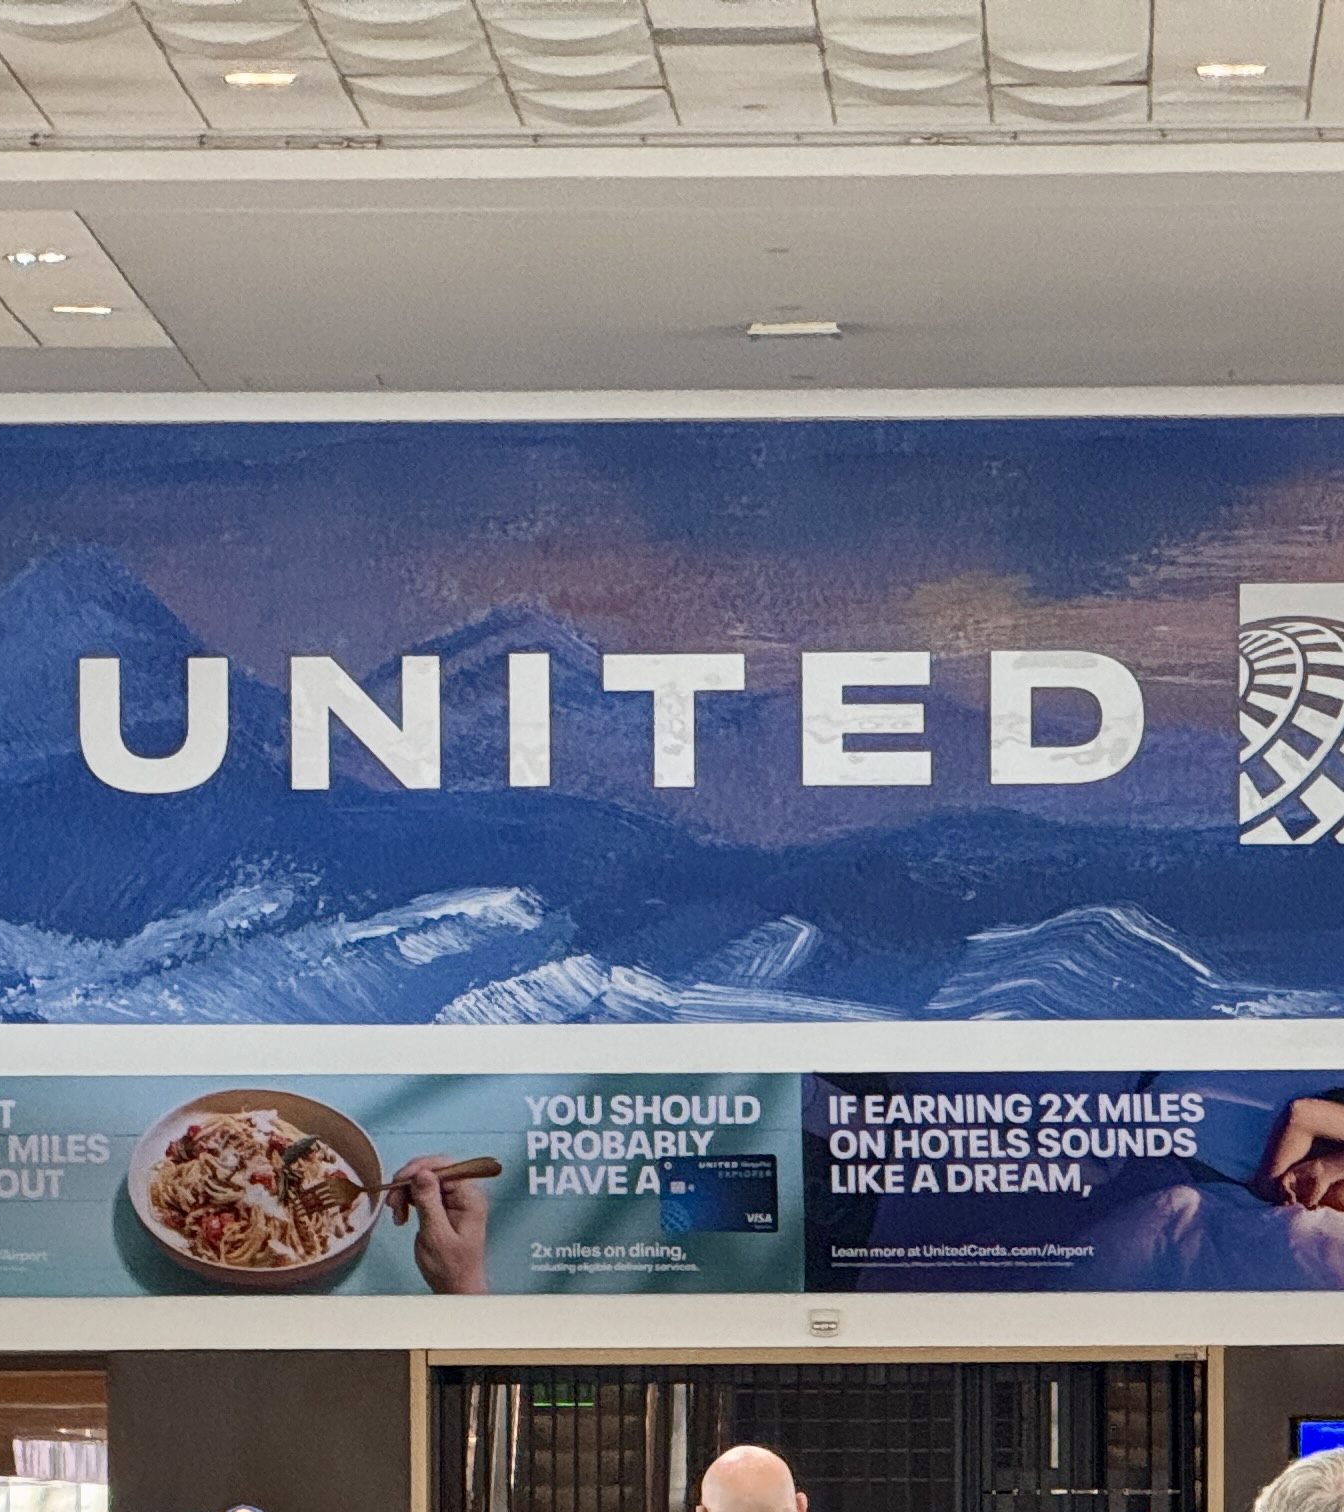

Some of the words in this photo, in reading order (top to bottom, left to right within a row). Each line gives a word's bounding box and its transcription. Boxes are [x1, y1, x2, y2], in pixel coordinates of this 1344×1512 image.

[79, 649, 1145, 794] UNITED
[524, 1094, 603, 1126] YOU
[609, 1094, 761, 1125] SHOULD
[829, 1094, 862, 1125] IF
[864, 1094, 1033, 1125] EARNING
[1039, 1093, 1091, 1124] 2X
[1098, 1092, 1206, 1124] MILES
[8, 1134, 111, 1164] MILES
[526, 1129, 715, 1161] PROBABLY
[829, 1128, 886, 1160] ON
[894, 1128, 1031, 1159] HOTELS
[1037, 1127, 1198, 1159] SOUNDS
[528, 1165, 628, 1195] HAVE
[635, 1164, 661, 1195] A
[830, 1163, 905, 1194] LIKE
[912, 1163, 940, 1194] A
[947, 1162, 1093, 1198] DREAM,
[745, 1212, 773, 1224] VISA
[530, 1242, 553, 1258] 2x
[556, 1241, 601, 1258] miles
[604, 1244, 626, 1258] on
[629, 1241, 687, 1261] dining,
[831, 1245, 868, 1258] Learn
[870, 1248, 905, 1258] more
[907, 1246, 922, 1258] at
[923, 1244, 1095, 1259] UnitedCards.com/Airport
